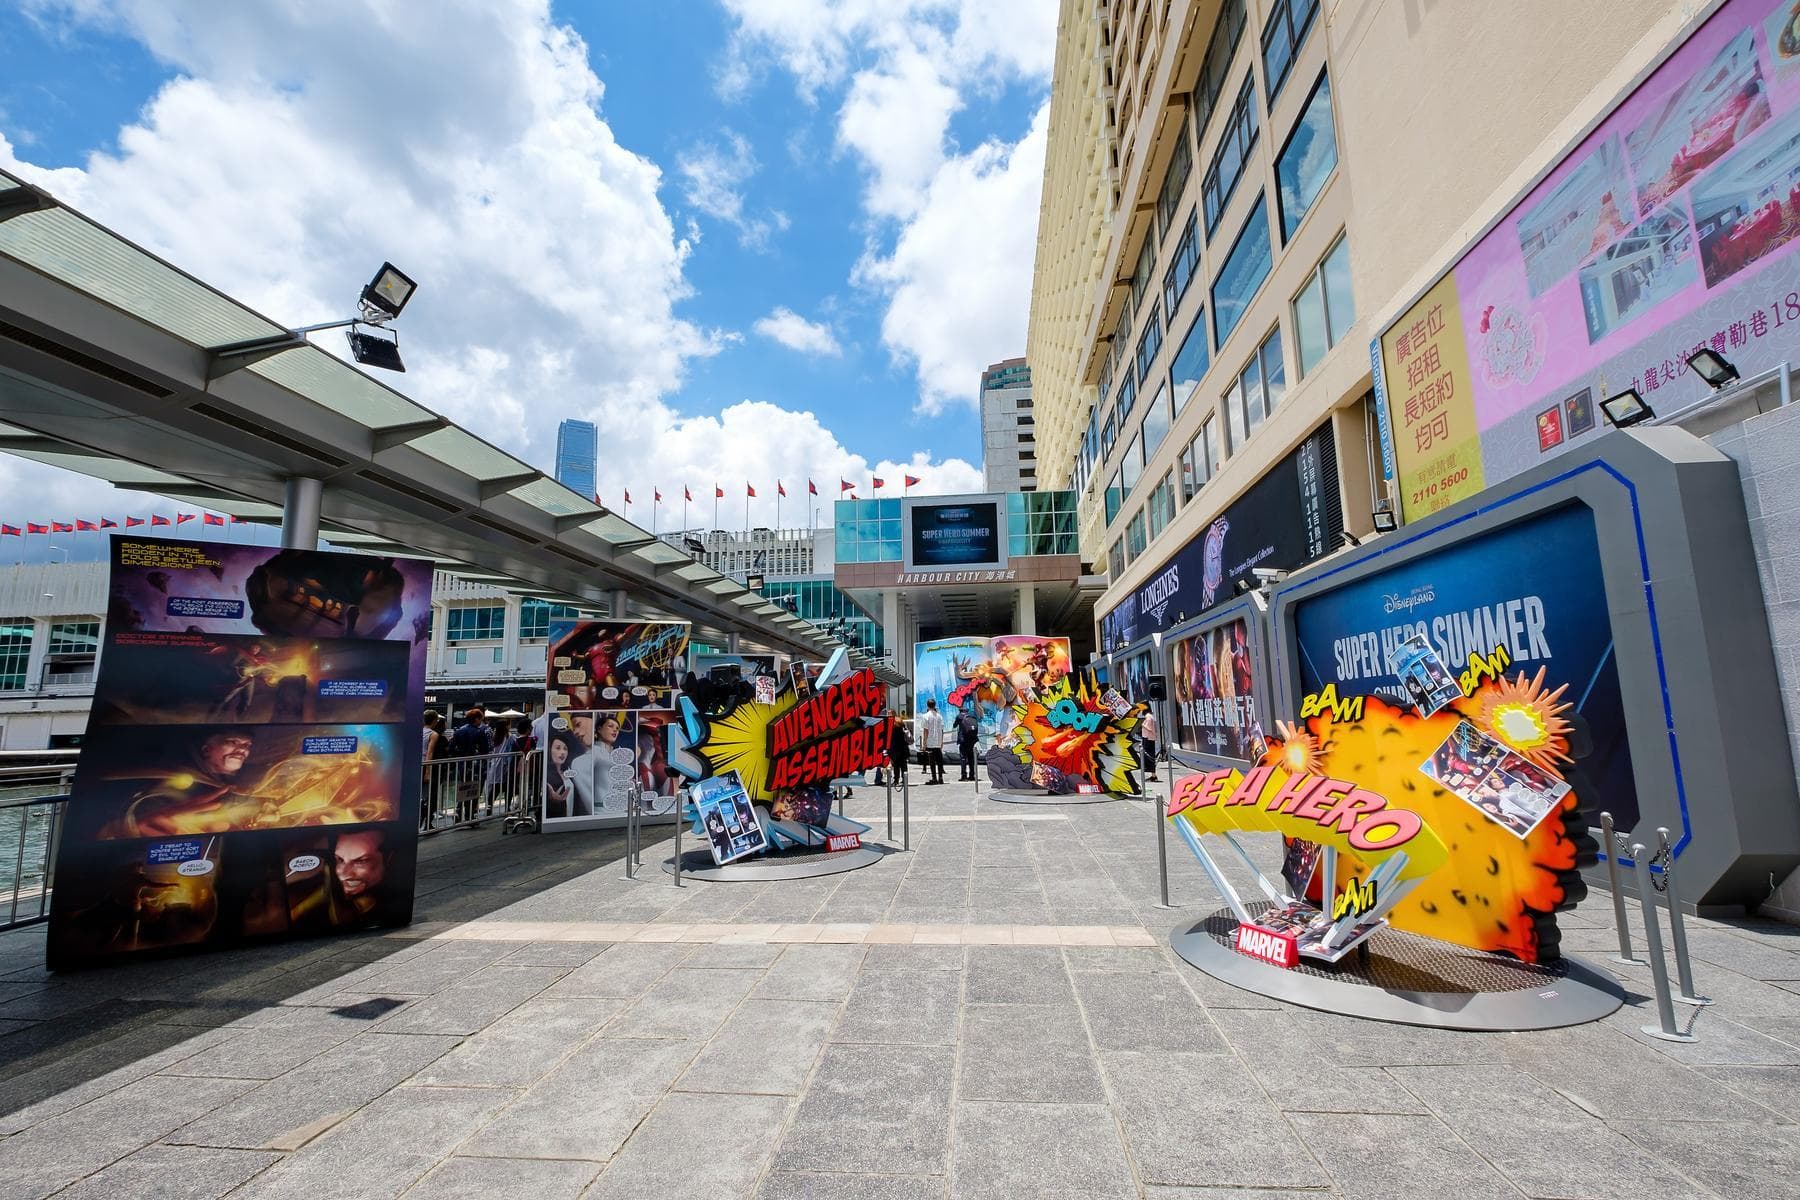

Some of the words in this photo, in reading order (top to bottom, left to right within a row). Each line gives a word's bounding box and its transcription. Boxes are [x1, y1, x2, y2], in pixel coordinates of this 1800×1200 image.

[1396, 304, 1446, 365] 廣告位
[1406, 343, 1441, 391] 招租
[1404, 370, 1454, 428] 長短約
[1378, 411, 1388, 440] 2110
[1415, 410, 1449, 453] 均可
[1412, 483, 1438, 504] 2110
[1440, 467, 1468, 490] 5600
[122, 543, 200, 554] SOMEWHERE
[922, 529, 942, 539] SUPER
[944, 529, 960, 538] HERO
[961, 528, 990, 538] SUMMER
[898, 573, 951, 584] HARBOUR
[956, 571, 981, 582] CITY
[1140, 564, 1179, 614] LONGINES
[1334, 631, 1382, 682] SUPER
[1432, 596, 1552, 669] SUMMER
[1458, 646, 1510, 697] BAM
[773, 667, 880, 756] AVENGERS
[1046, 698, 1104, 733] BOOM
[1300, 683, 1364, 722] BAM
[770, 716, 896, 790] ASSEMBLE!
[1079, 784, 1100, 793] MARVEL
[1167, 768, 1234, 817] BE
[1224, 766, 1278, 806] A
[1266, 772, 1422, 850] HERO
[830, 835, 860, 850] MARVEL
[1333, 878, 1376, 921] BAM
[1238, 927, 1288, 964] MARVEL
